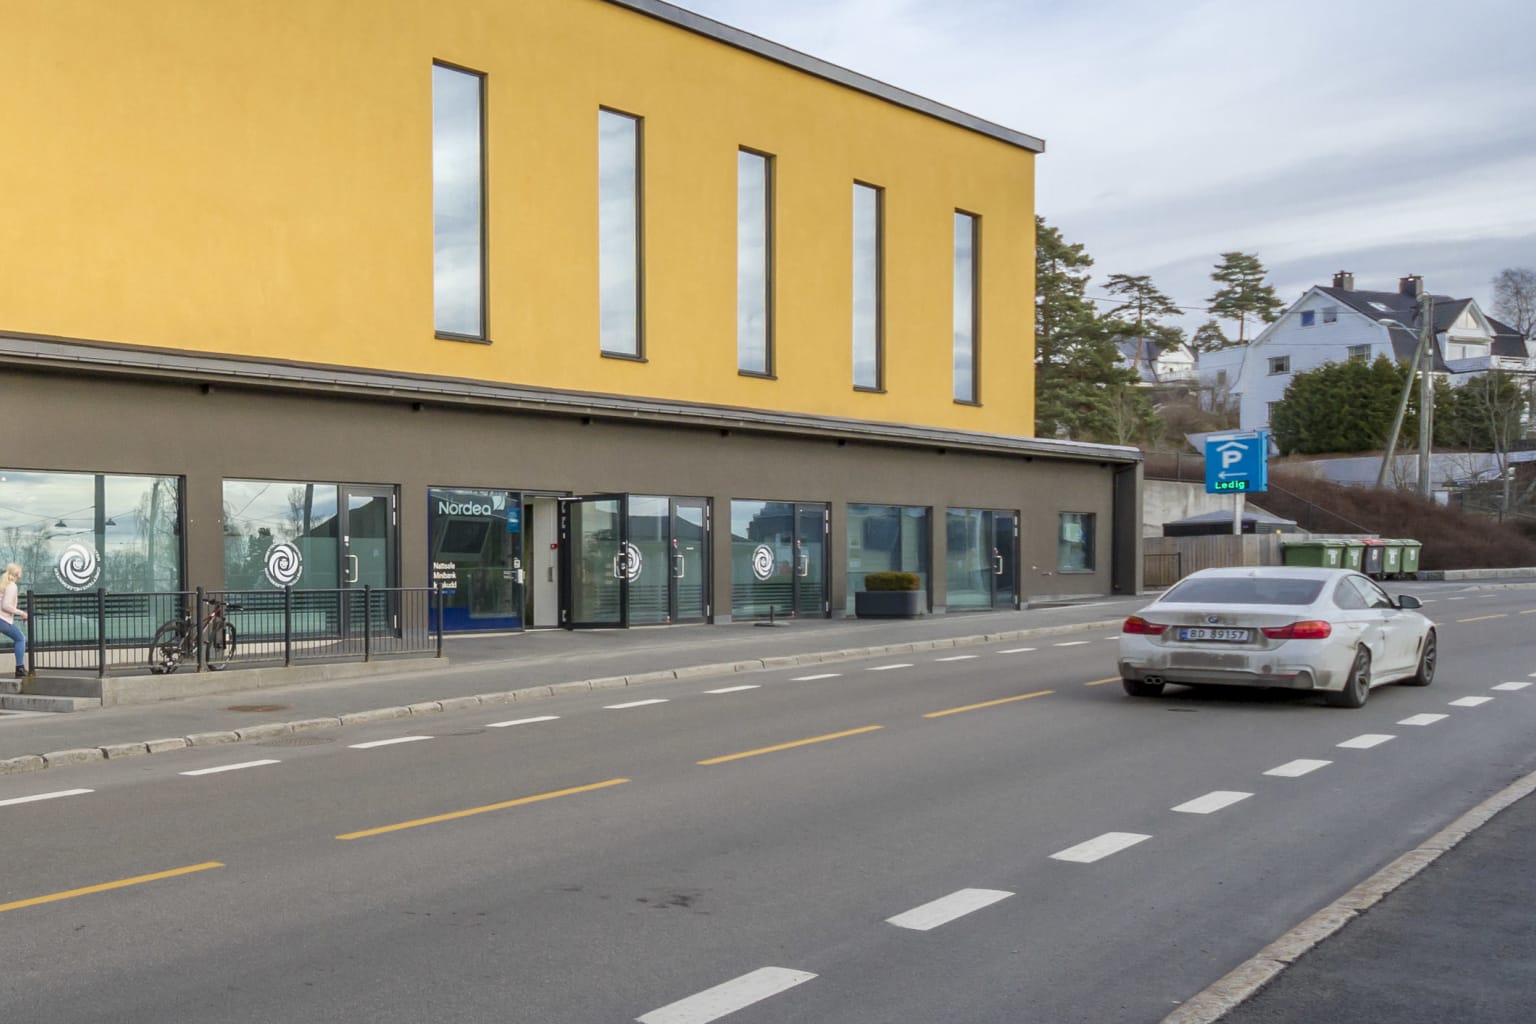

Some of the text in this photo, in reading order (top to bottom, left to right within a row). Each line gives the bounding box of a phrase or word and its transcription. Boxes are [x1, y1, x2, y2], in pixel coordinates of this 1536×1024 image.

[1222, 450, 1243, 469] P
[1215, 480, 1245, 490] Ledig
[438, 501, 492, 516] Nordea
